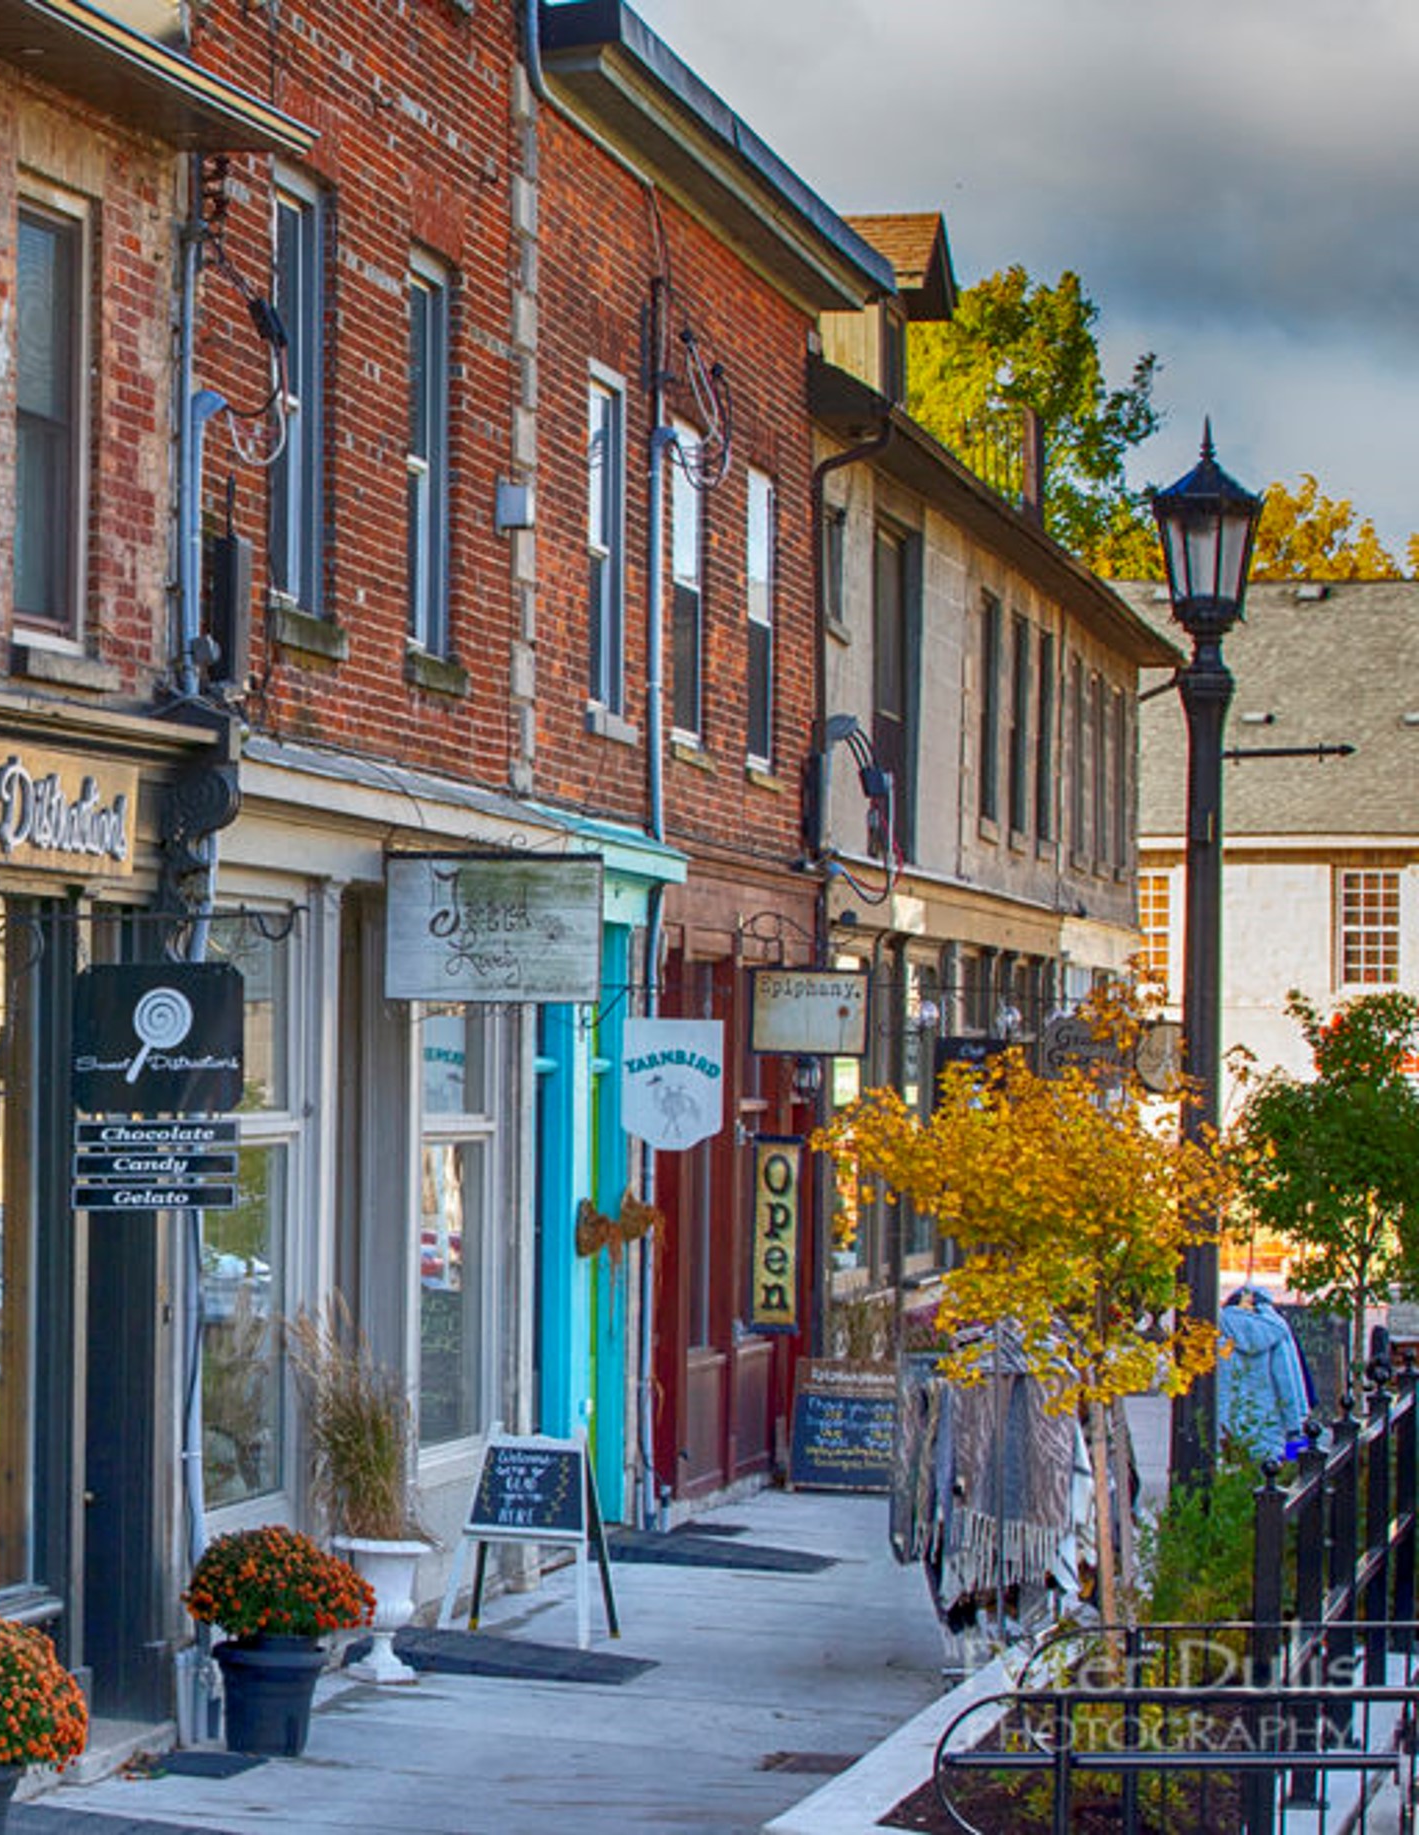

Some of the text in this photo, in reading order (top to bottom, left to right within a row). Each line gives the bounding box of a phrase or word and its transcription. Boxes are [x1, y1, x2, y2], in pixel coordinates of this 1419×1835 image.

[624, 1049, 722, 1080] YARNBIRD
[100, 1127, 215, 1143] Chocolate
[112, 1157, 188, 1174] Candy
[112, 1190, 189, 1205] Gelato
[762, 1153, 792, 1312] Open
